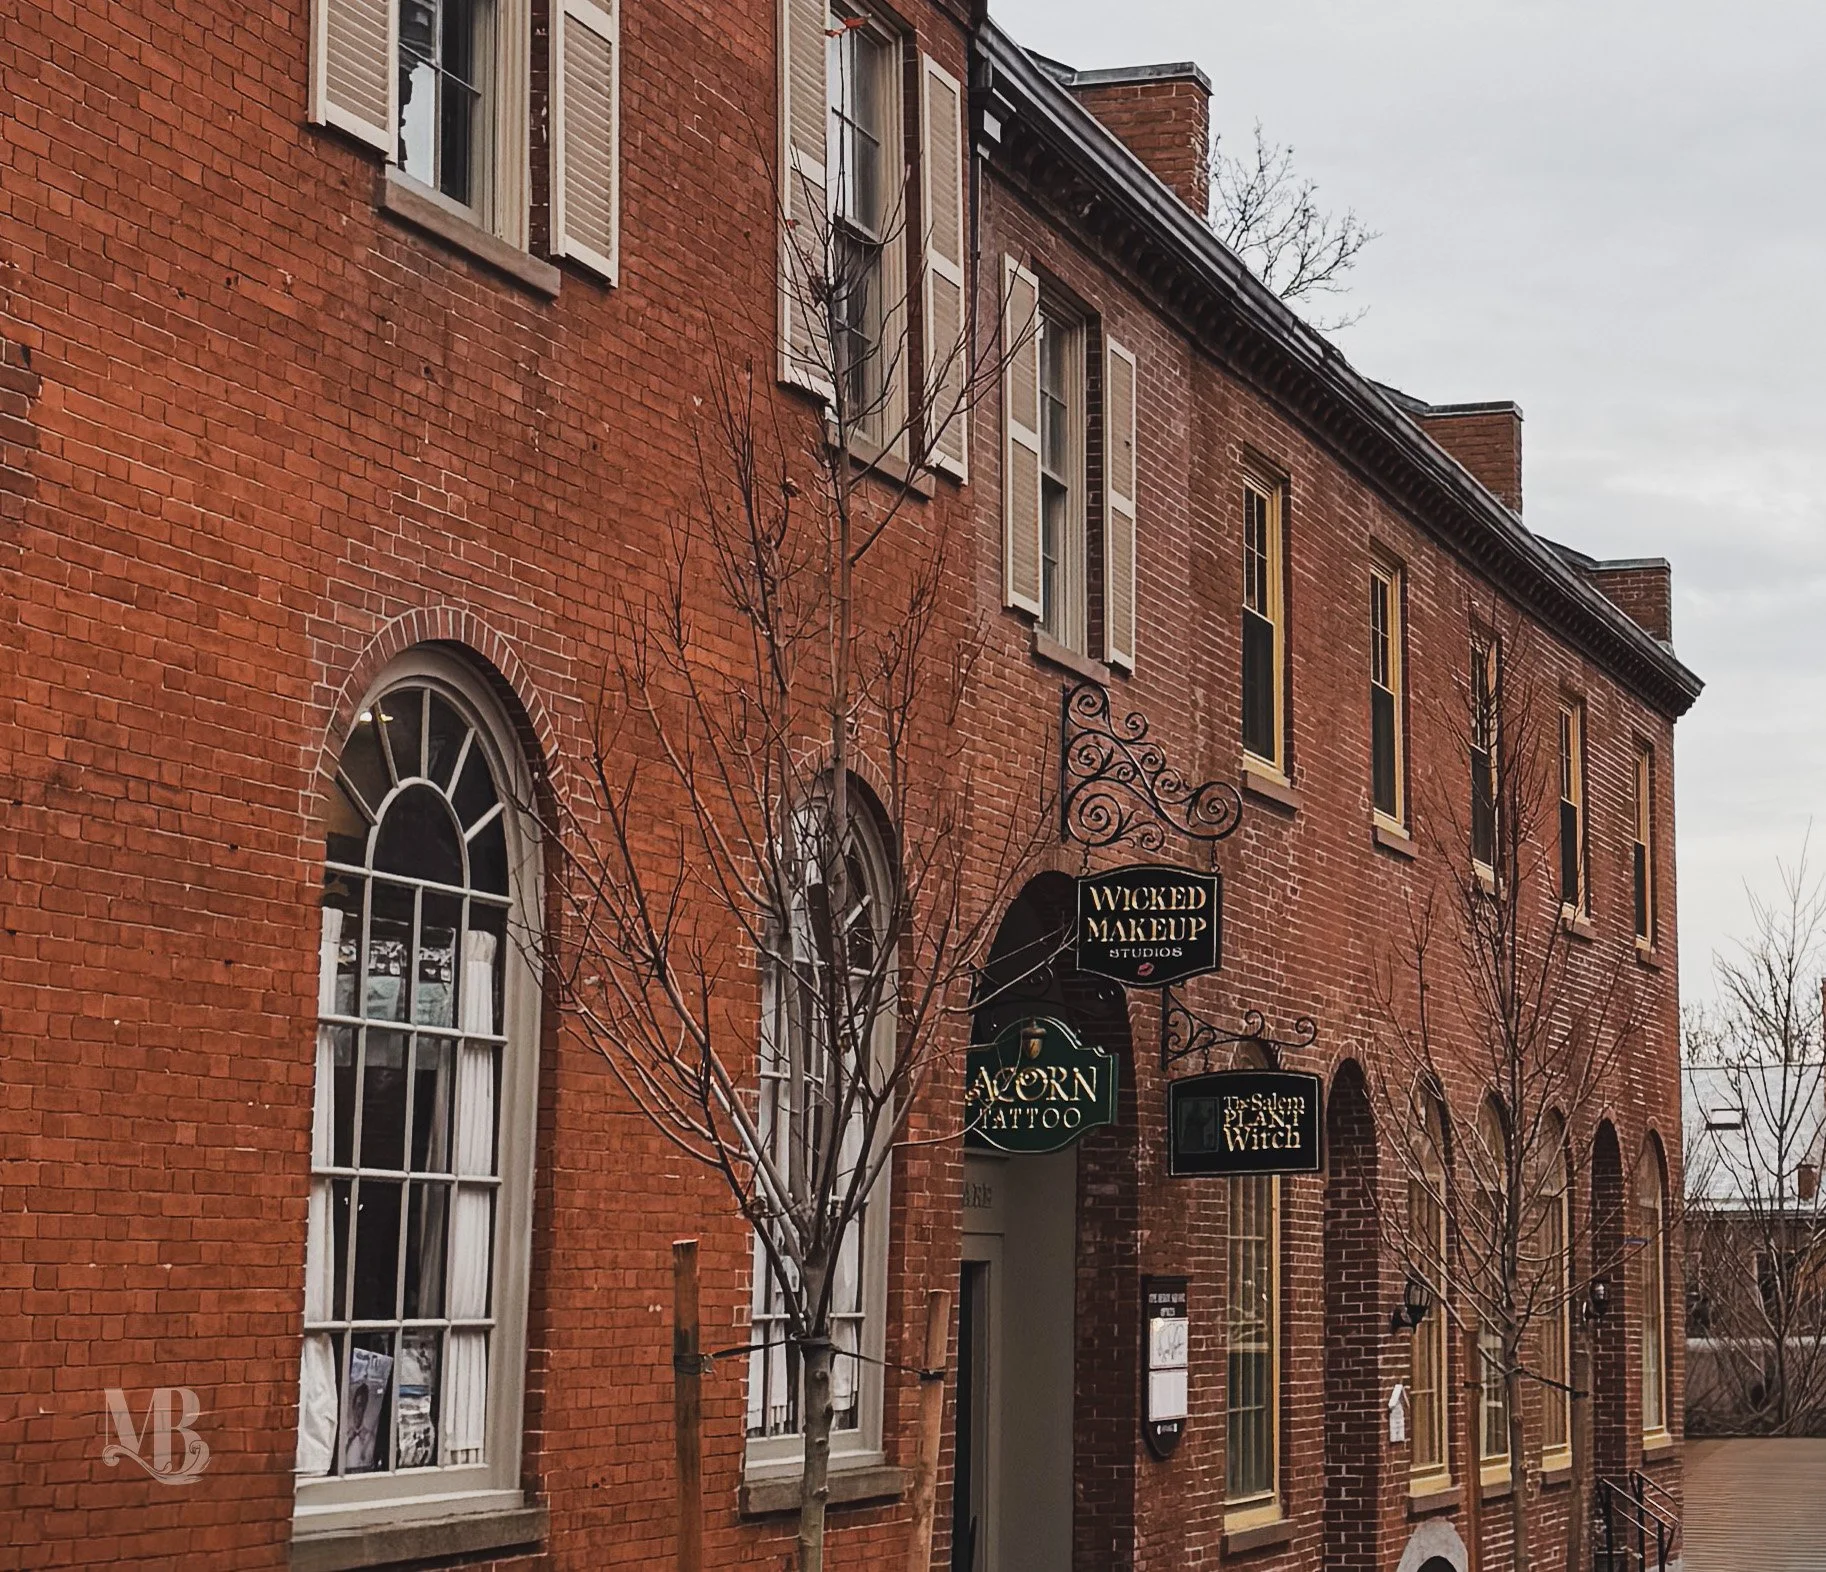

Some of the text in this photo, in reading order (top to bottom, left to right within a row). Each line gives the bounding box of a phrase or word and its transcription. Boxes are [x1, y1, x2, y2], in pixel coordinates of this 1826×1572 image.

[1089, 886, 1207, 911] WICKED
[1087, 917, 1207, 942] MAKEUP
[1109, 947, 1183, 958] STUDIOS
[965, 1066, 1097, 1105] ACORN
[1251, 1092, 1305, 1111] Salem
[980, 1107, 1081, 1129] TATTOO
[1223, 1107, 1305, 1128] PLANT
[1223, 1125, 1301, 1152] Witch
